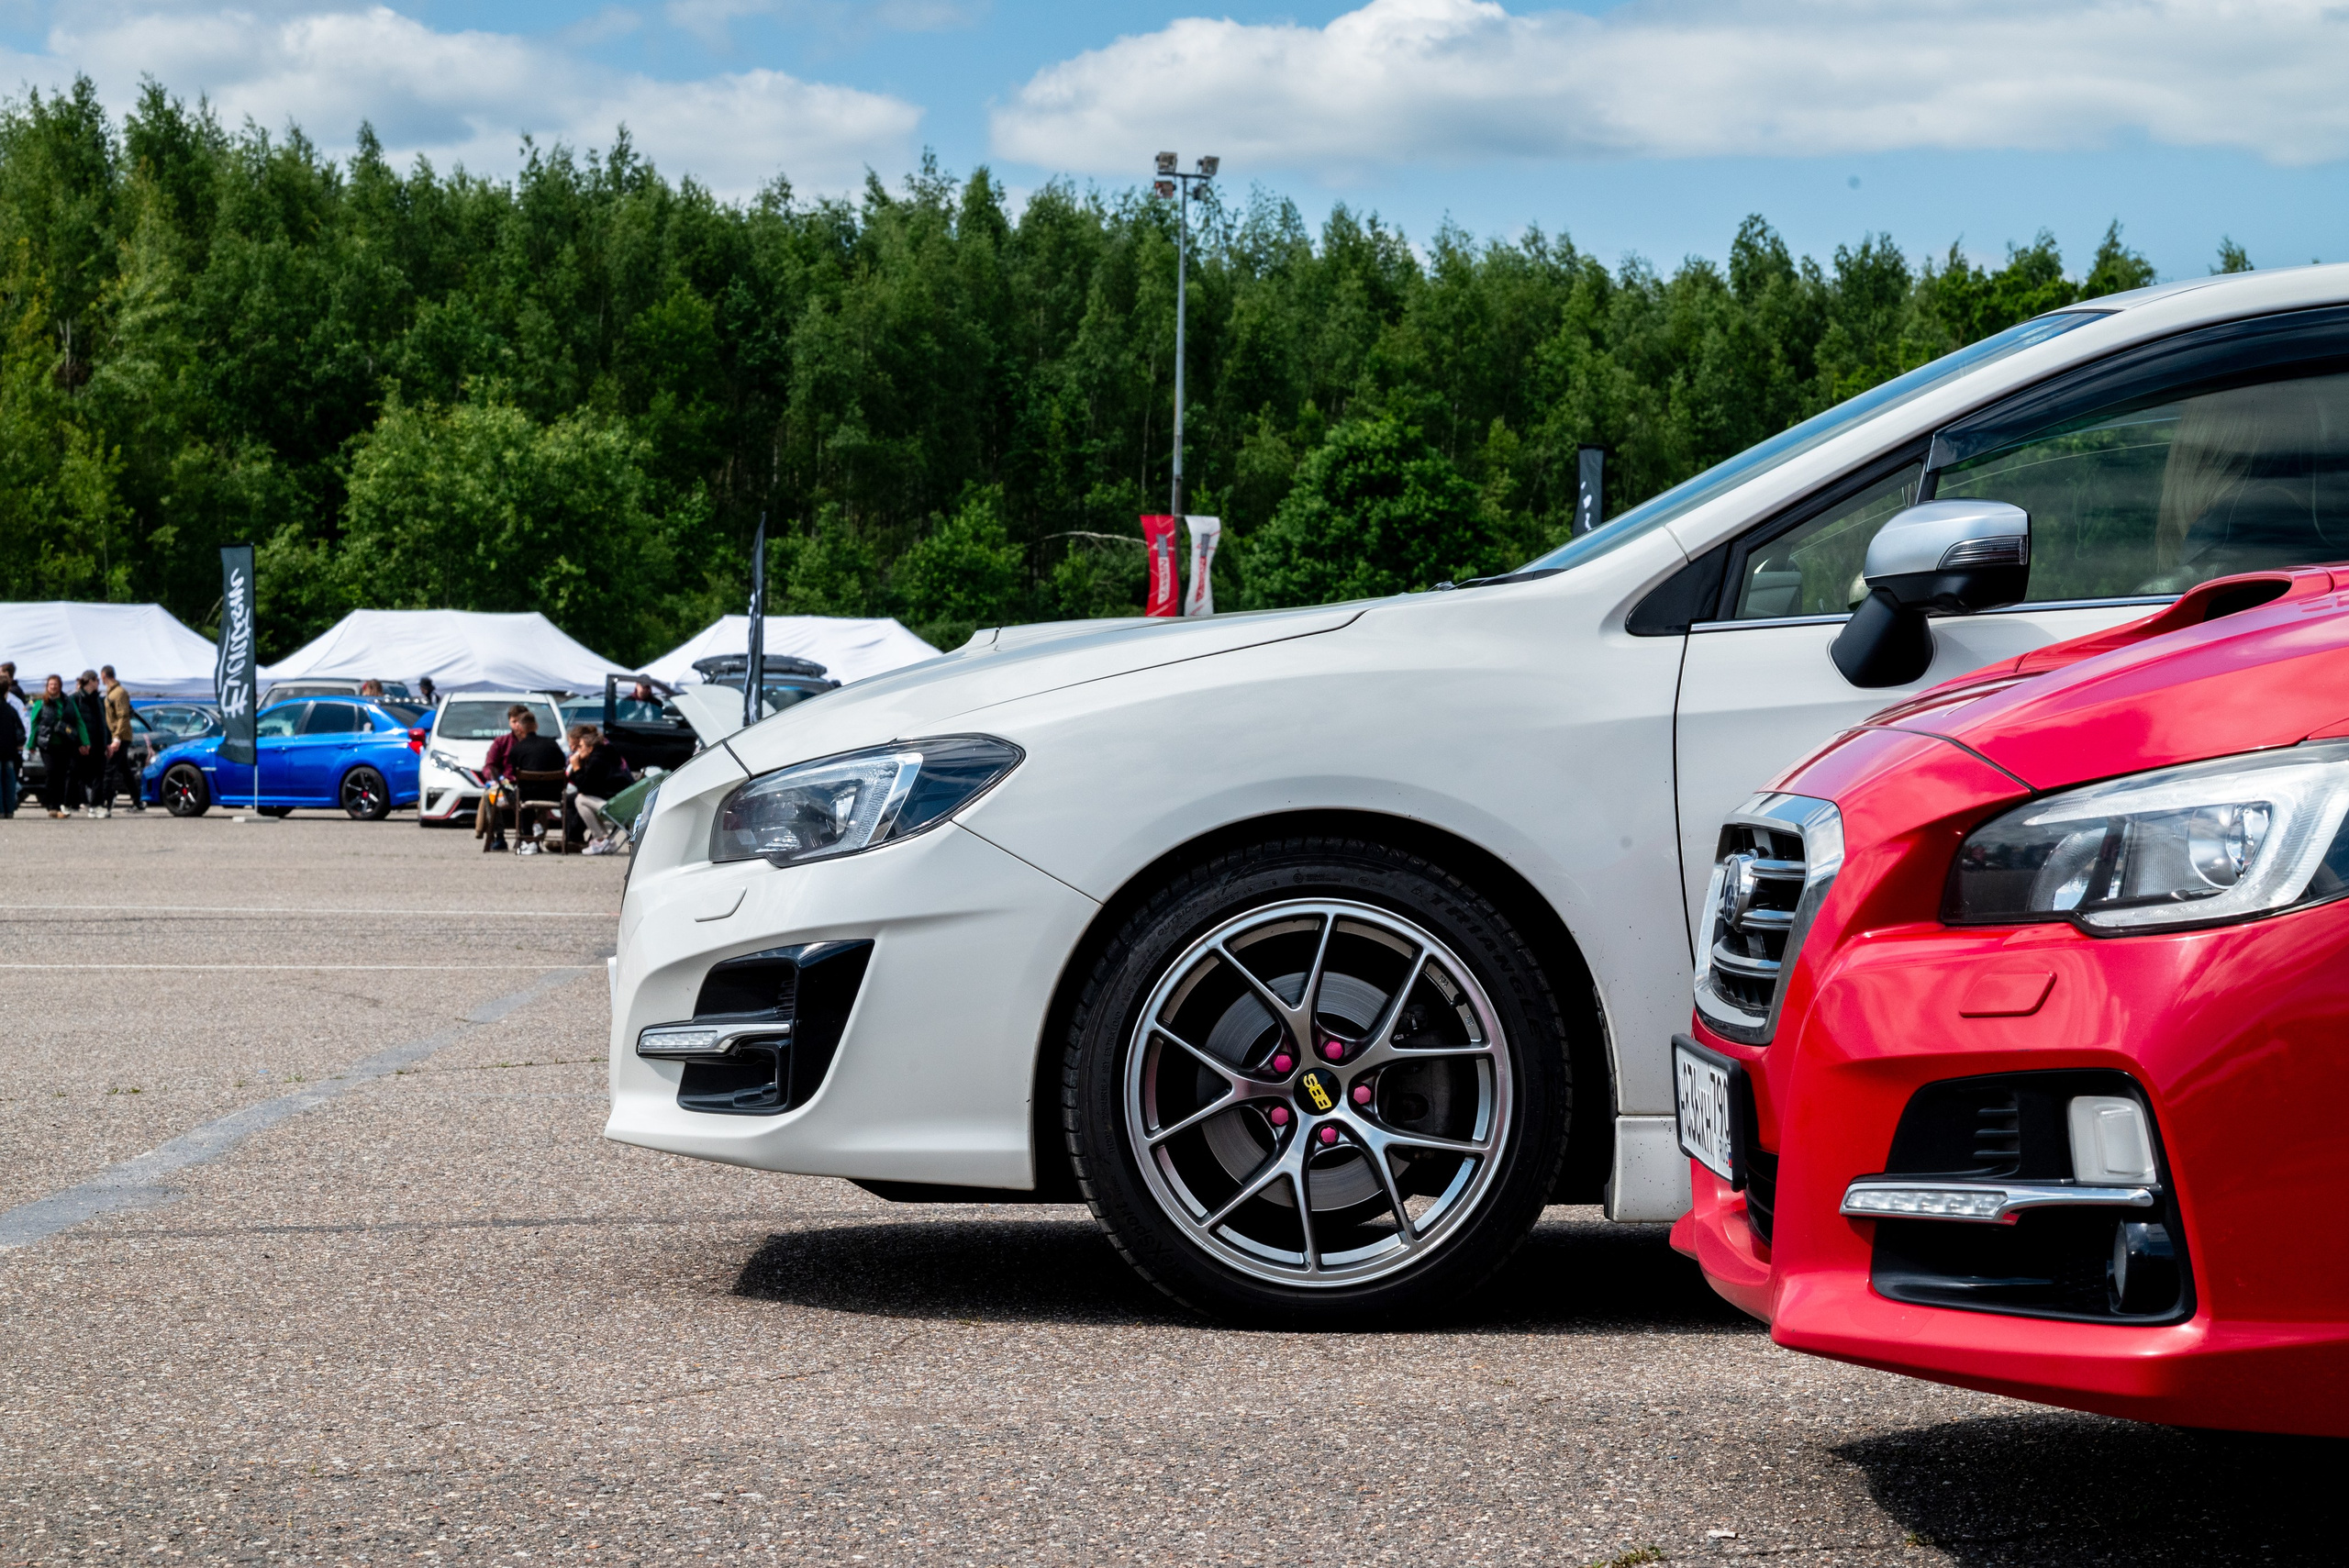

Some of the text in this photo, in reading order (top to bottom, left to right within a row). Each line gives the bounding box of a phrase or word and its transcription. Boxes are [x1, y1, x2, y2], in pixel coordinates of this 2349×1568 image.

[1156, 900, 1198, 937] OUTSIDE
[1428, 891, 1543, 1038] TRIANGLE
[1110, 1010, 1123, 1031] LOAD
[1103, 1030, 1118, 1057] EXTRA
[1303, 1073, 1332, 1110] BBS
